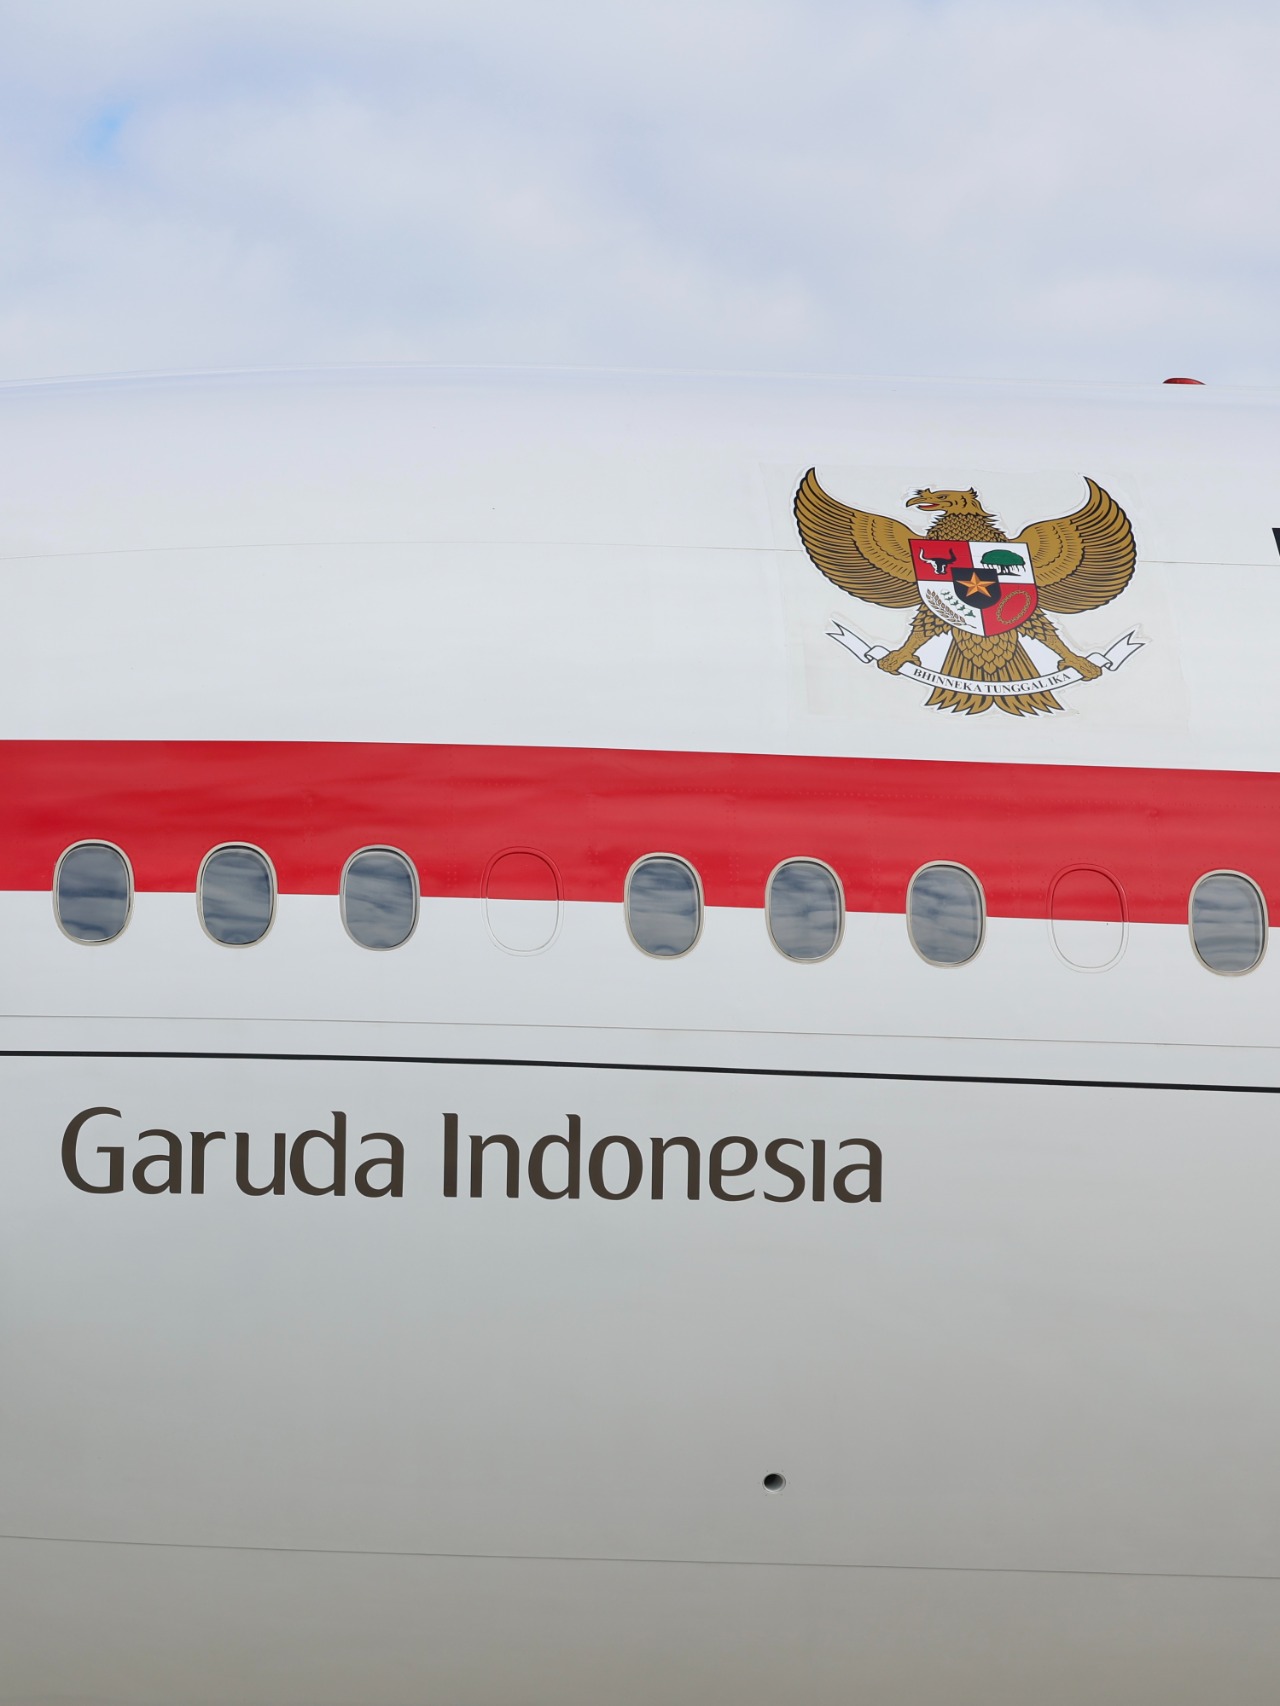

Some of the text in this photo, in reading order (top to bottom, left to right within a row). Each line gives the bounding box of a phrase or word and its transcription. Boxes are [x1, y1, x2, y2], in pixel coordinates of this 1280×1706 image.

[913, 668, 1072, 694] BHINNEKA TUNGGAL IKA
[62, 1106, 883, 1203] Garuda Indonesia
